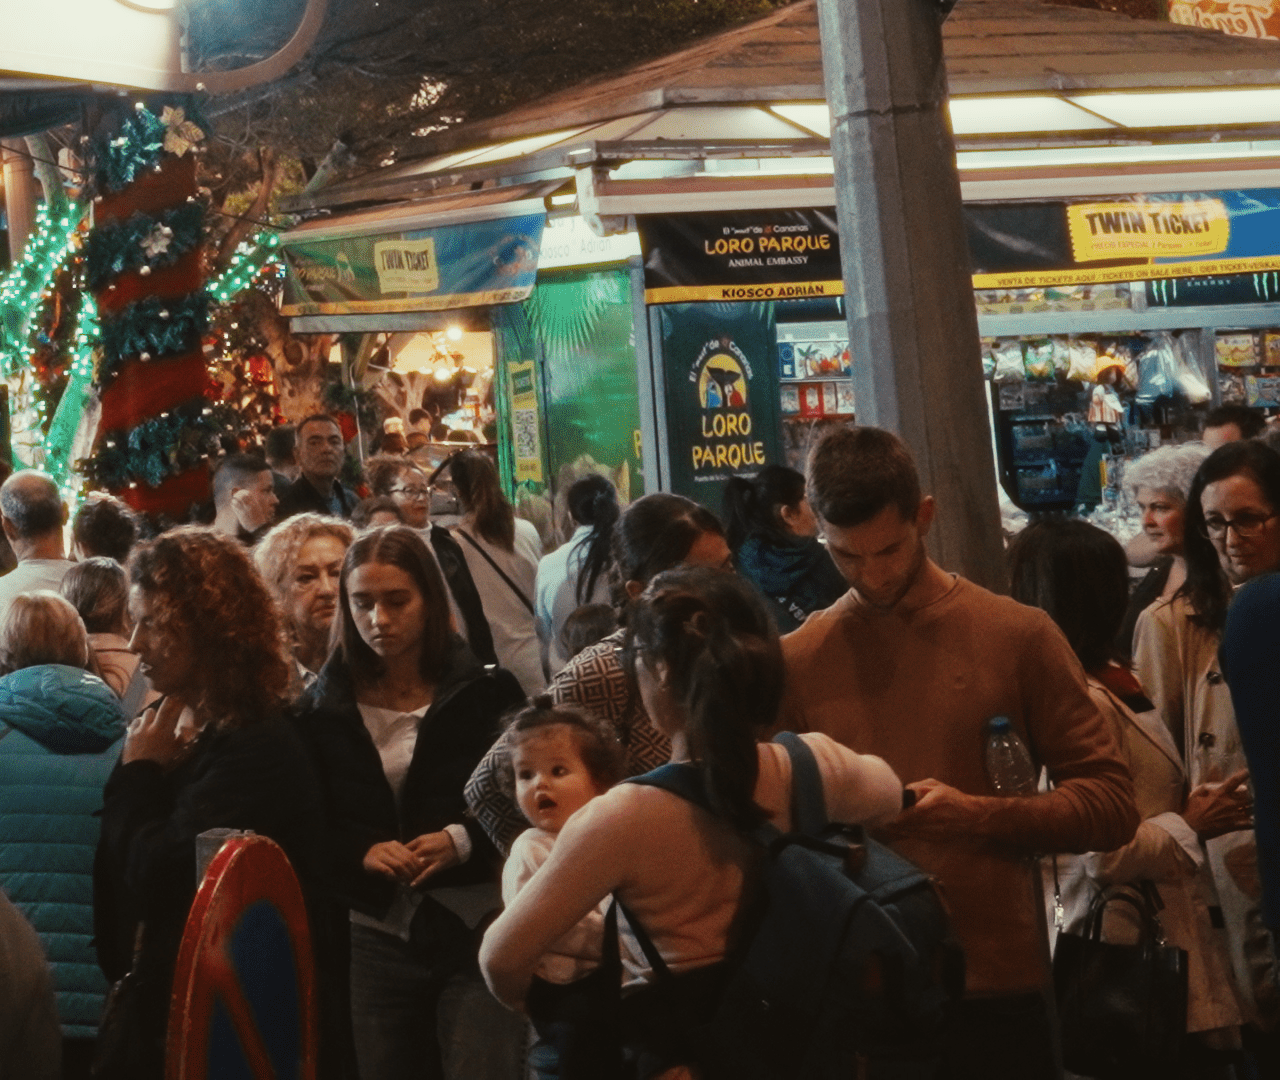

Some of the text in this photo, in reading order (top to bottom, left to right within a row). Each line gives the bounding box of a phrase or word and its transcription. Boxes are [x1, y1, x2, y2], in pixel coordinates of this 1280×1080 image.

[772, 224, 809, 234] Canarias
[1085, 211, 1211, 236] TWIN TICKET
[704, 234, 831, 255] LORO PARQUE
[379, 249, 404, 271] TWIN
[728, 255, 809, 268] ANIMAL EMBASSY
[721, 288, 775, 299] KIOSCO
[1187, 279, 1232, 288] ENERGY
[701, 412, 752, 438] LORO
[692, 441, 766, 471] PARQUE
